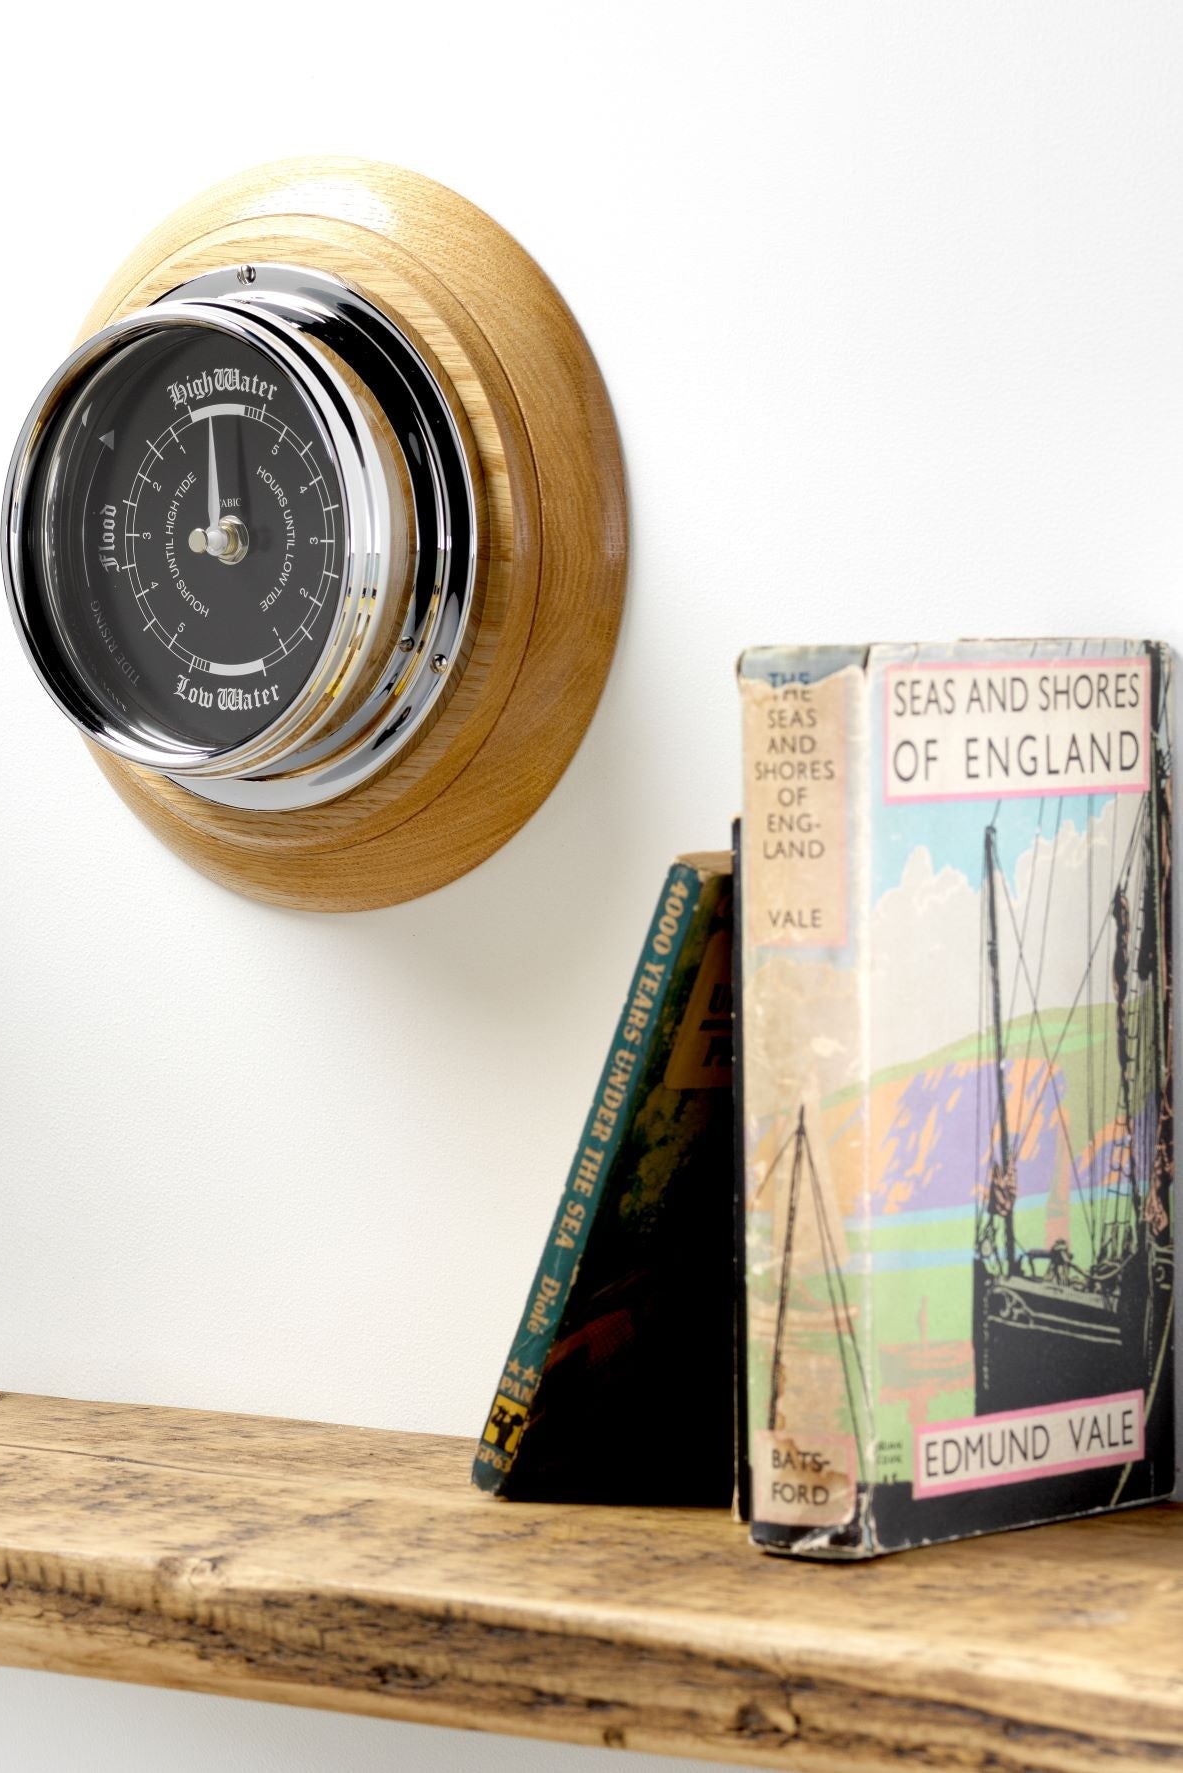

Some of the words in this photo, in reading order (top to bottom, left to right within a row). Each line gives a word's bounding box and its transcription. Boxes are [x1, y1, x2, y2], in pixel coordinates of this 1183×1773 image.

[167, 370, 213, 410] High
[214, 368, 278, 401] Water
[271, 444, 280, 456] 5
[152, 481, 162, 492] 2
[174, 471, 198, 499] TIDE
[256, 465, 288, 508] HOURS
[299, 485, 308, 494] 4
[219, 497, 242, 508] ABIC
[165, 500, 180, 535] HIGH
[283, 509, 296, 551] UNTIL
[98, 503, 120, 573] Flood
[142, 531, 152, 540] 3
[309, 536, 319, 545] 3
[165, 537, 180, 579] UNTIL
[279, 553, 294, 587] LOW
[176, 579, 210, 618] HOURS
[259, 586, 283, 613] TIDE
[299, 587, 309, 598] 2
[177, 621, 186, 633] 5
[114, 652, 141, 686] TIDE
[174, 674, 213, 708] Low
[217, 684, 279, 711] Water
[893, 678, 956, 717] SEAS
[966, 677, 1028, 714] AND
[1038, 672, 1140, 711] SHORES
[767, 708, 818, 729] SEAS
[767, 735, 817, 755] AND
[893, 738, 939, 783] OF
[965, 730, 1140, 780] ENGLAND
[754, 760, 836, 781] SHORES
[777, 787, 808, 807] OF
[767, 813, 822, 833] ENG-
[762, 839, 826, 860] LAND
[652, 879, 689, 956] 4000
[767, 908, 823, 929] VALE
[623, 960, 666, 1046] YEARS
[590, 1048, 636, 1143] UNDER
[573, 1146, 606, 1198] THE
[554, 1200, 587, 1250] SEA
[924, 1424, 1051, 1478] EDMUND
[1068, 1409, 1135, 1452] VALE
[770, 1448, 832, 1472] BATS-
[770, 1481, 830, 1506] FORD
